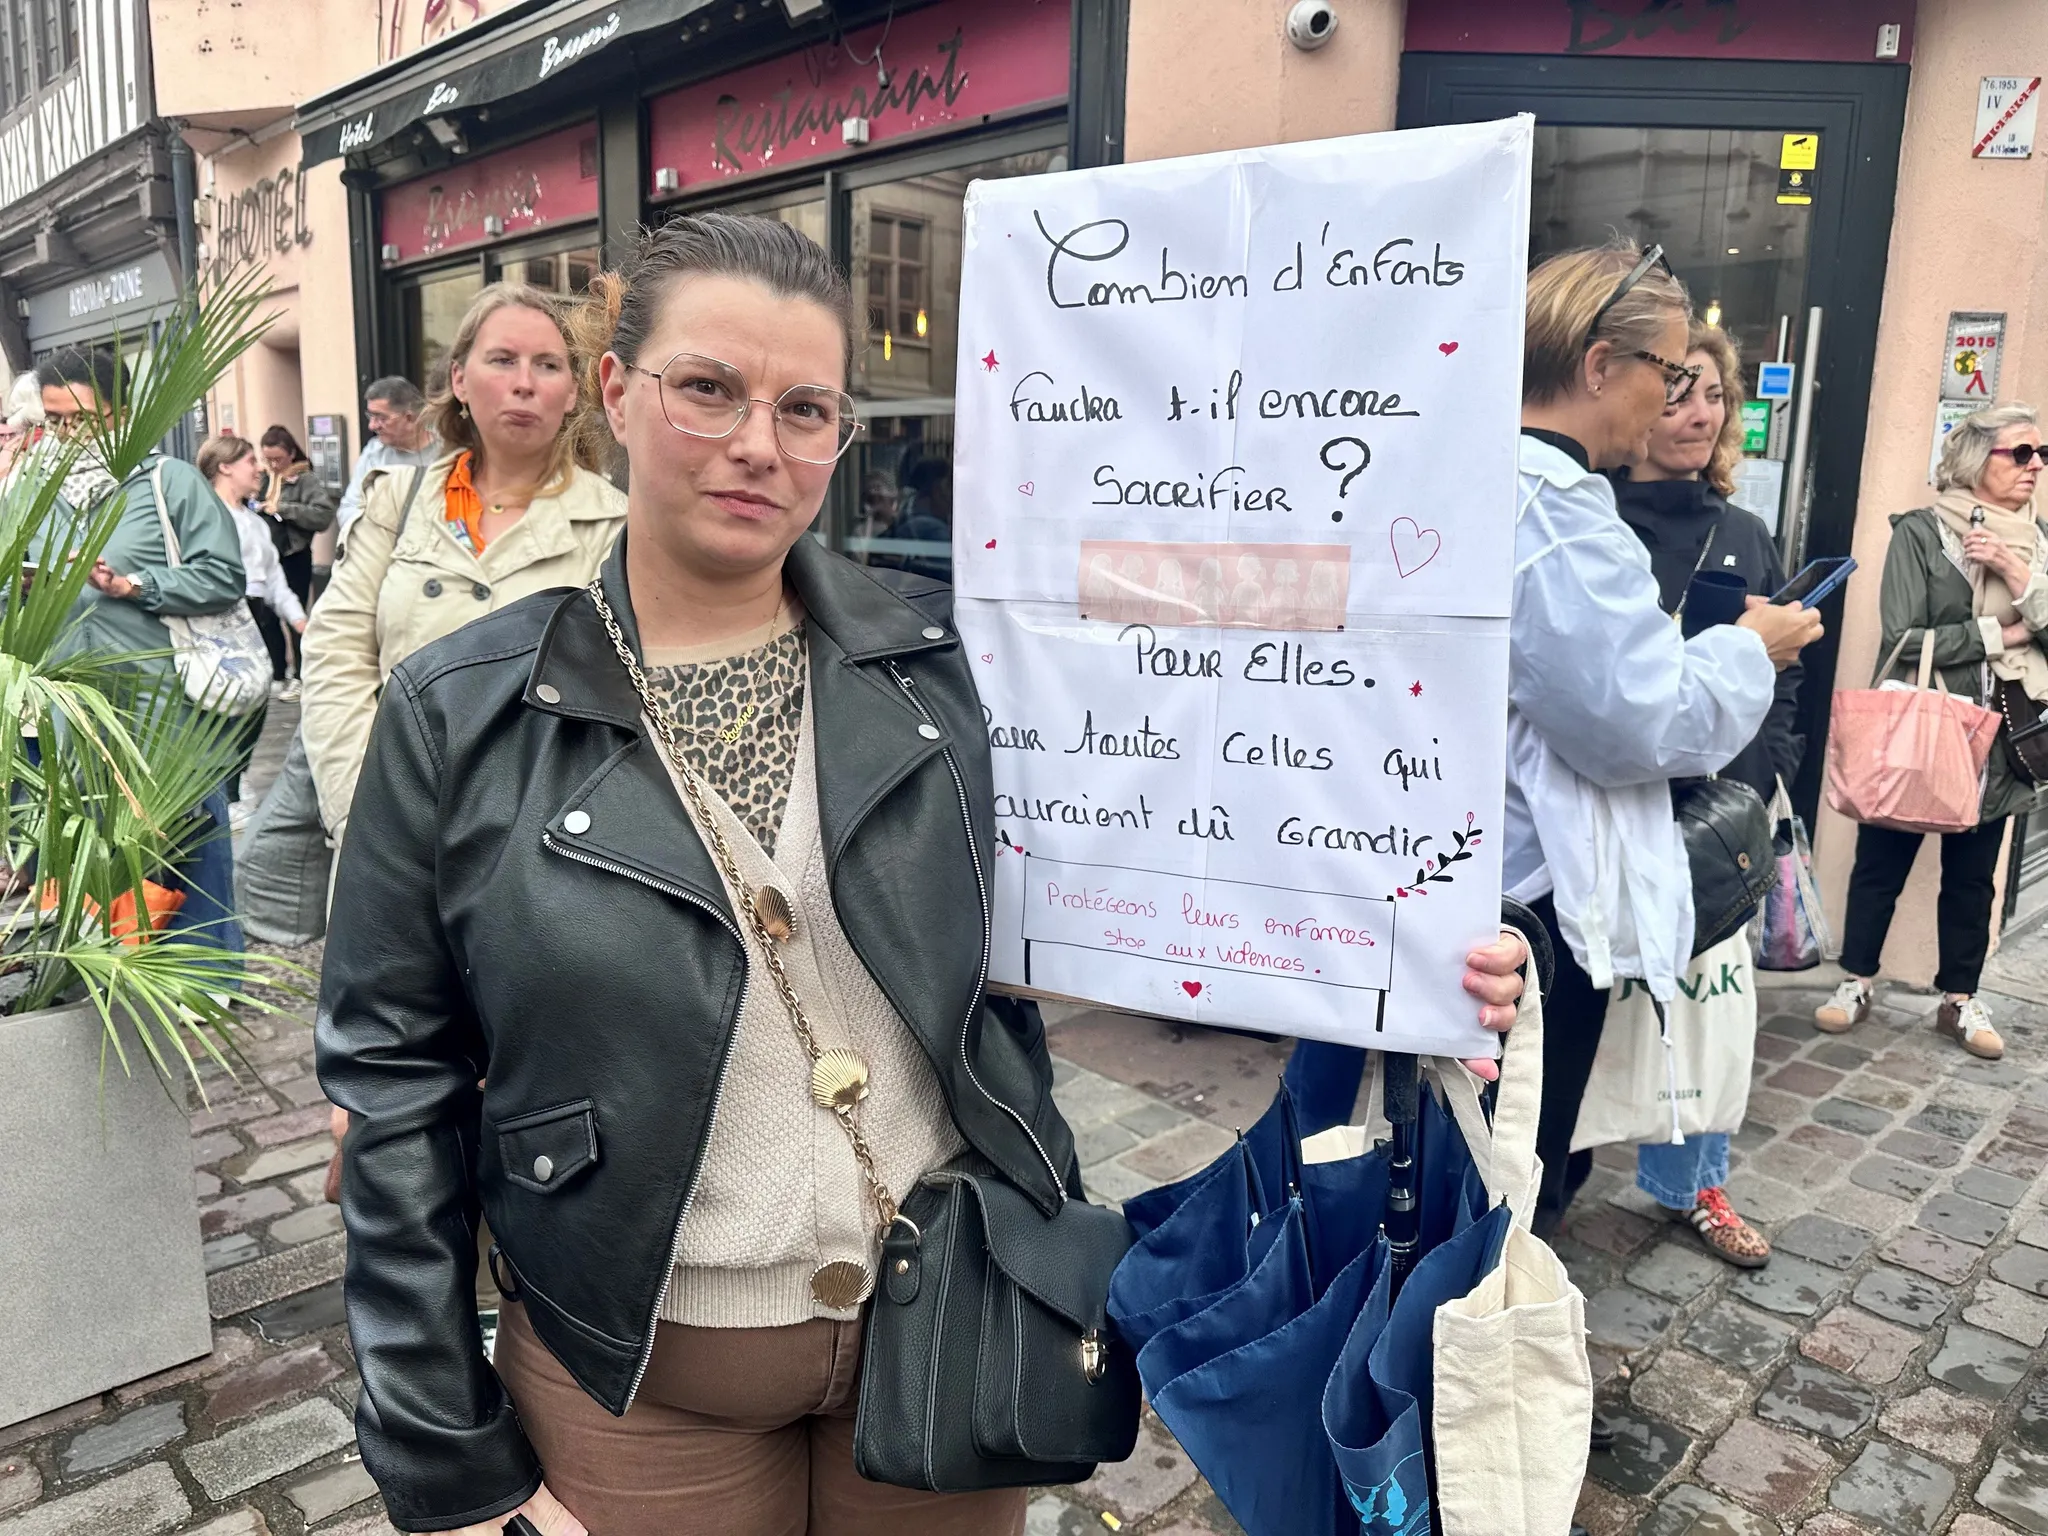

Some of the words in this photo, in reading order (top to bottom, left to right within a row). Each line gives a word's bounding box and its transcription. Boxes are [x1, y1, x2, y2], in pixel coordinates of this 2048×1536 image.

[422, 81, 460, 115] Bar
[538, 11, 621, 78] Brasserie
[712, 26, 969, 171] Restaurant
[1980, 86, 2033, 148] LICENCE
[216, 161, 314, 286] HOTEL
[1033, 209, 1248, 309] Combien
[1955, 336, 1996, 348] 2015
[1319, 436, 1371, 523] ?
[1243, 640, 1376, 688] Elles.
[1383, 737, 1442, 791] qui
[1178, 805, 1235, 841] dû
[1180, 892, 1239, 929] leurs
[1165, 942, 1206, 960] aux
